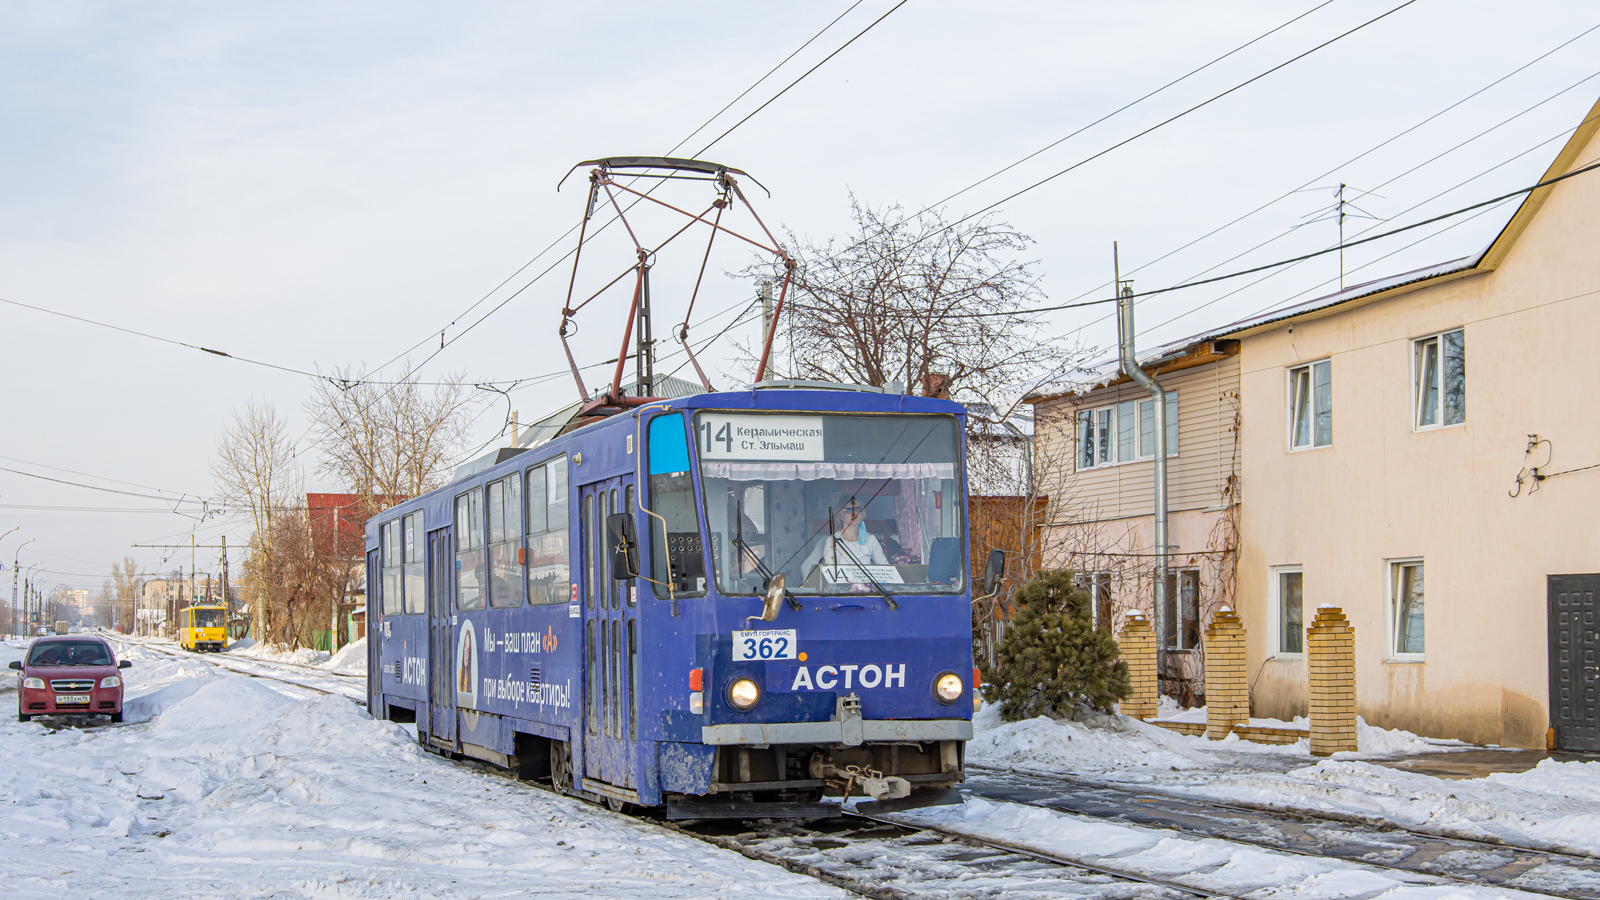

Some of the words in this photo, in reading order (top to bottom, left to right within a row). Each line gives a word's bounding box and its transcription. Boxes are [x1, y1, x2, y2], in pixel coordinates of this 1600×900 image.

[700, 421, 733, 452] 14
[737, 427, 822, 438] Керамическая
[741, 440, 757, 450] Ст.
[759, 440, 805, 450] Эльмаш
[484, 627, 496, 653] Мы
[505, 632, 520, 653] ваш
[521, 632, 541, 654] план
[542, 625, 558, 654] «А»
[743, 637, 788, 659] 362
[402, 656, 426, 687] АСТОН
[791, 663, 906, 691] АСТОН
[483, 677, 497, 706] при
[497, 672, 525, 710] выборе
[526, 678, 570, 716] квартиры!
